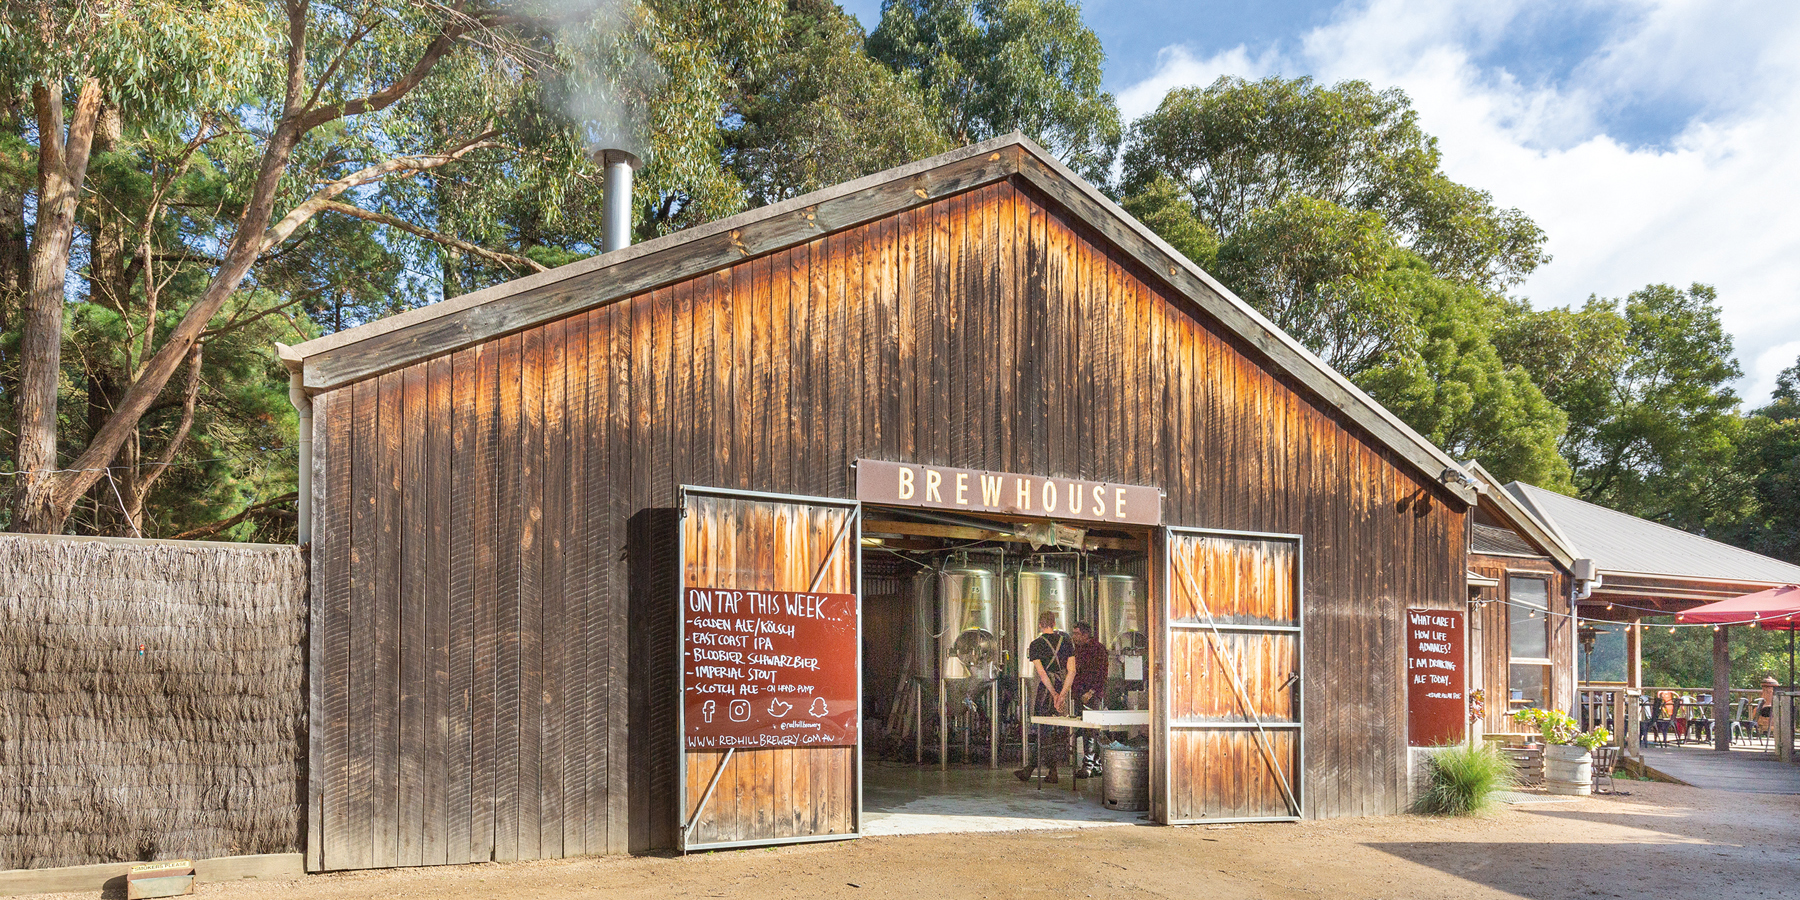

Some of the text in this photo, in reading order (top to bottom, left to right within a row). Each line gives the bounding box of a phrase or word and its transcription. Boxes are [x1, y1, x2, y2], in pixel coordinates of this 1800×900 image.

[898, 466, 1127, 518] BREWHOUSE
[690, 589, 842, 621] ON TAP THIS WEEK...
[1410, 613, 1455, 629] WHAT CARE I
[718, 634, 749, 648] COAST
[754, 637, 774, 651] IPA
[1414, 629, 1447, 641] HOW LIFE
[1418, 642, 1452, 654] ADVANCES?
[747, 652, 821, 672] SCHWARZBIER
[1408, 657, 1414, 669] I
[1416, 658, 1428, 668] AM
[747, 667, 777, 684] STOUT
[1413, 674, 1452, 687] ALE TODAY.
[739, 683, 759, 696] ALE
[777, 684, 796, 694] HAND
[797, 685, 815, 695] PUMP
